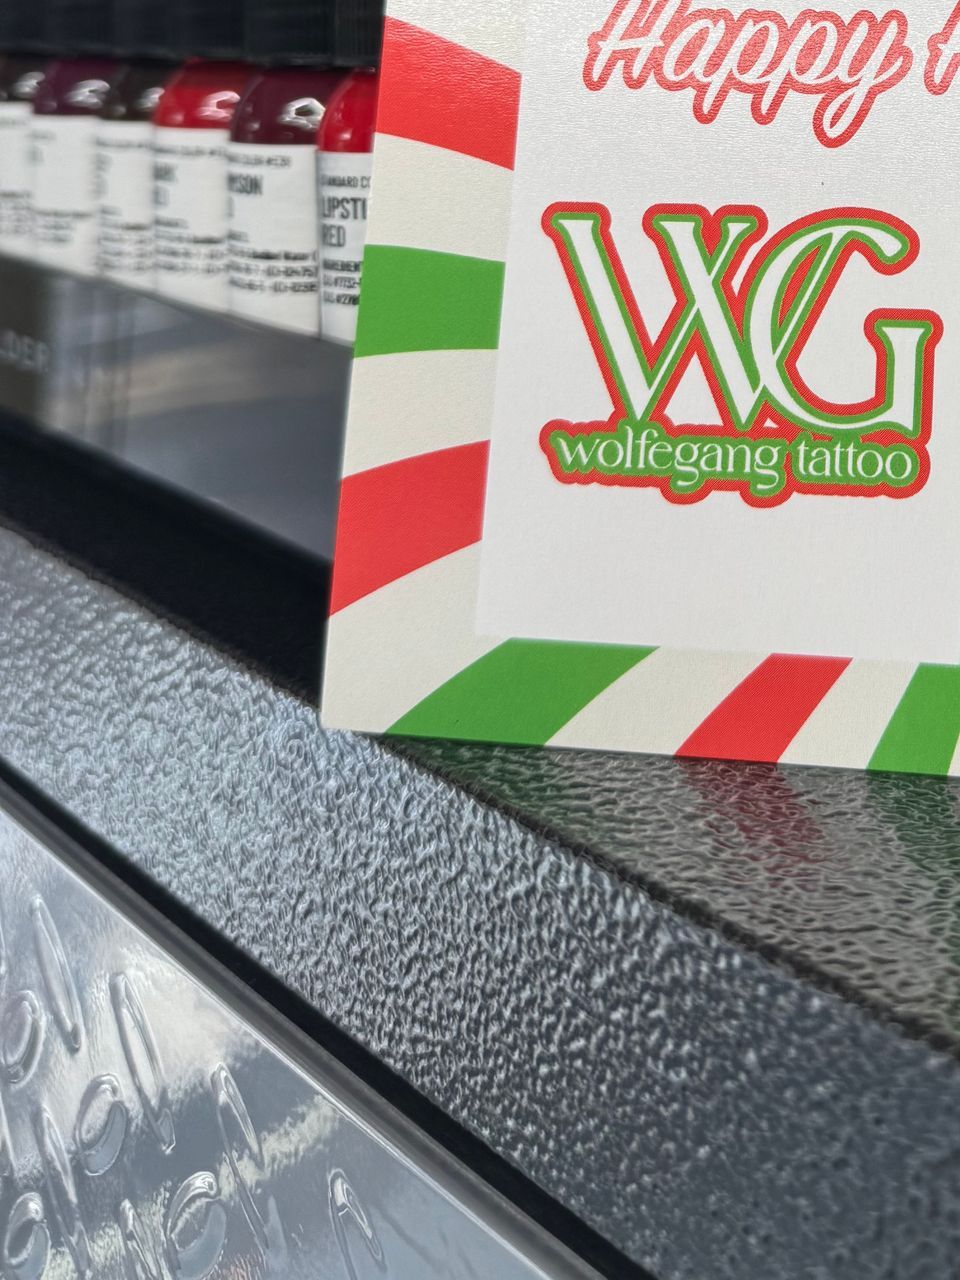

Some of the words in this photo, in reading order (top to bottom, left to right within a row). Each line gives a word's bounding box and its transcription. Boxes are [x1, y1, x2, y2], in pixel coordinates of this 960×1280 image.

[542, 202, 943, 432] WG
[550, 421, 787, 496] wolfegang
[794, 434, 918, 486] tattoo
